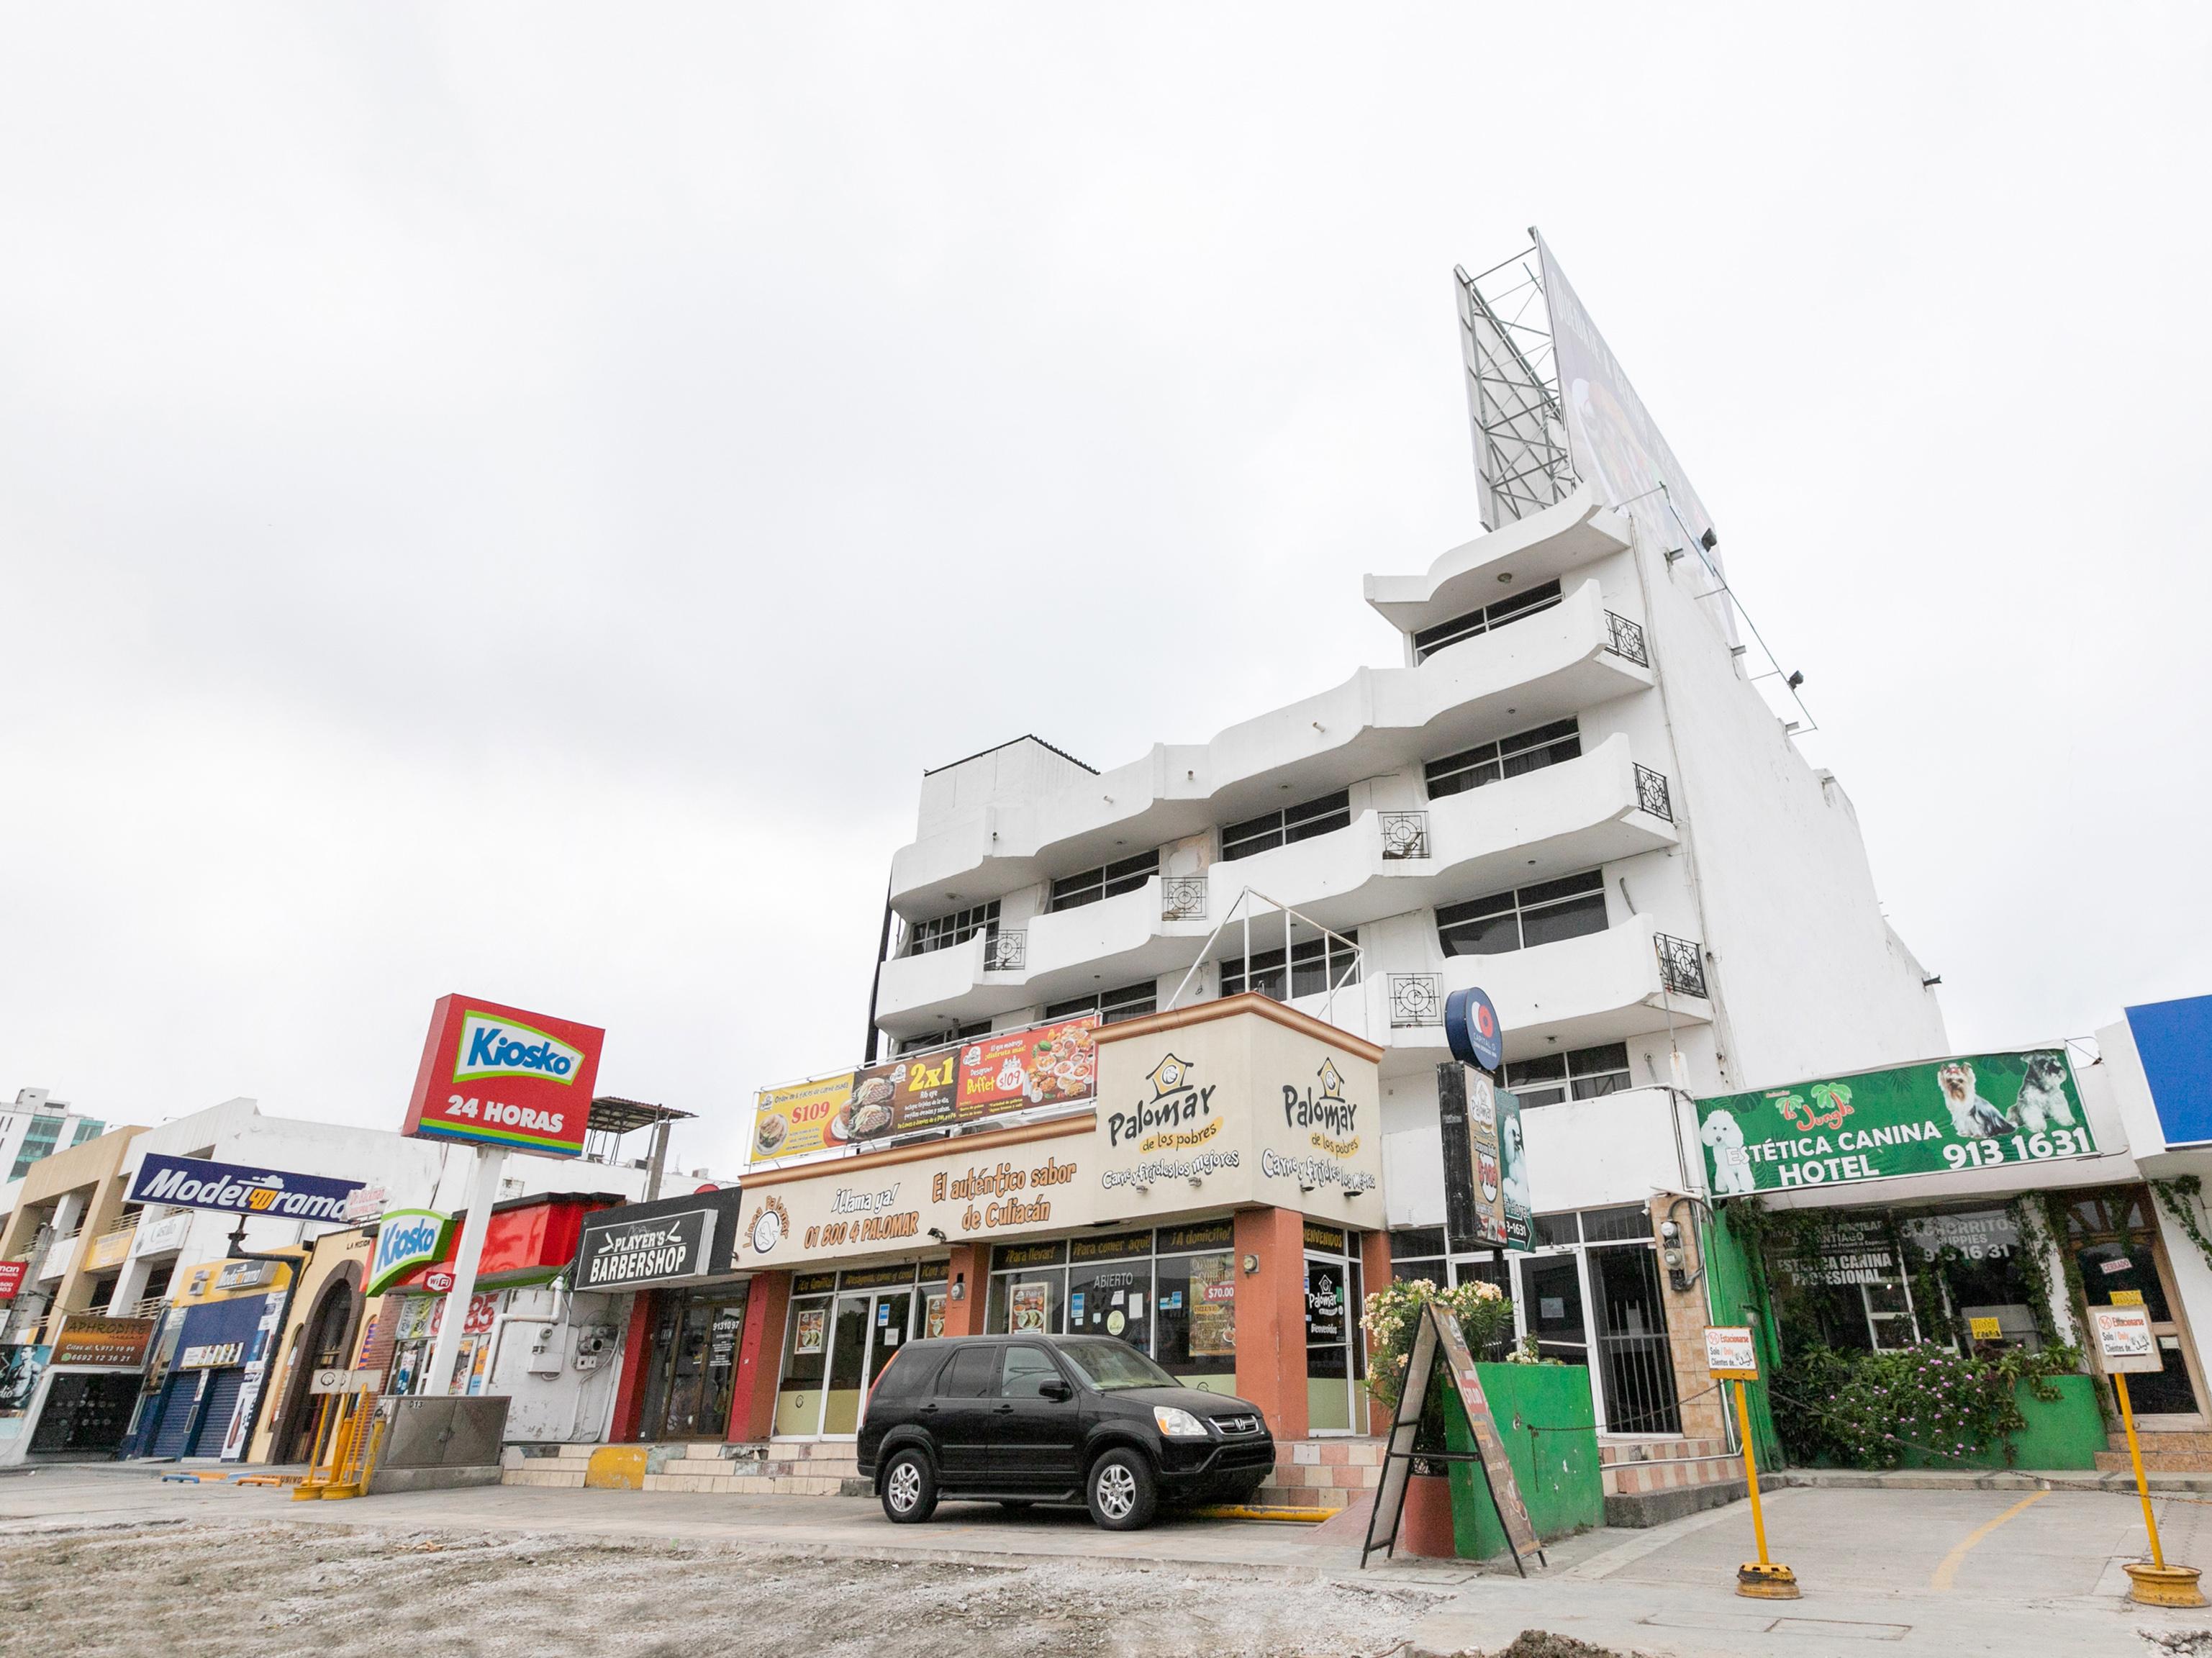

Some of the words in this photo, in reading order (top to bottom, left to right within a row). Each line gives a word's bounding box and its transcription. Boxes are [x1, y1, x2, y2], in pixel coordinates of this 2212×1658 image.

[467, 1027, 571, 1075] Kiosko
[908, 1056, 954, 1092] 2x1
[966, 1076, 995, 1095] Buffet
[445, 1095, 479, 1118] 24
[484, 1100, 564, 1133] HORAS
[1108, 1084, 1216, 1147] Palomar
[1282, 1084, 1357, 1136] Palomar
[1143, 1139, 1154, 1151] de
[1157, 1132, 1173, 1148] los
[1176, 1123, 1217, 1151] pobres
[1312, 1133, 1320, 1145] de
[1323, 1132, 1334, 1153] los
[1336, 1139, 1359, 1160] pobres
[1726, 1135, 1833, 1166] ESTÉTICA
[1838, 1120, 1942, 1151] CANINA
[1943, 1139, 2004, 1169] 913
[2011, 1127, 2091, 1161] 1631
[932, 1172, 948, 1203] El
[951, 1162, 1026, 1201] auténtico
[1030, 1156, 1077, 1187] sabor
[1102, 1169, 1131, 1189] Carne
[1130, 1172, 1141, 1186] y
[1138, 1159, 1174, 1184] frijoles
[1174, 1160, 1190, 1179] los
[1192, 1149, 1239, 1175] mejores
[1262, 1148, 1297, 1178] Carne
[1297, 1161, 1305, 1181] y
[1306, 1155, 1341, 1187] frijoles
[1341, 1167, 1353, 1190] los
[1778, 1154, 1880, 1187] HOTEL
[874, 1182, 901, 1214] ya!
[961, 1204, 982, 1231] de
[985, 1194, 1051, 1228] Culiacán
[766, 1195, 790, 1240] Palomar
[804, 1226, 820, 1249] 01
[820, 1222, 848, 1246] 800
[849, 1220, 859, 1244] 4
[860, 1210, 920, 1241] PALOMAR
[376, 1218, 435, 1273] Kiosko
[614, 1230, 665, 1253] PLAYER'S
[1961, 1244, 1983, 1260] 16
[1987, 1244, 2011, 1259] 31
[430, 1277, 451, 1287] WiFi
[589, 1246, 686, 1284] BARBERSHOP
[1093, 1272, 1133, 1289] ABIERTO
[2103, 1260, 2130, 1272] CERRADO
[1208, 1287, 1234, 1299] $70.00
[1309, 1292, 1337, 1309] Palomar
[68, 1321, 147, 1334] APHRODITE
[2102, 1332, 2114, 1341] Solo
